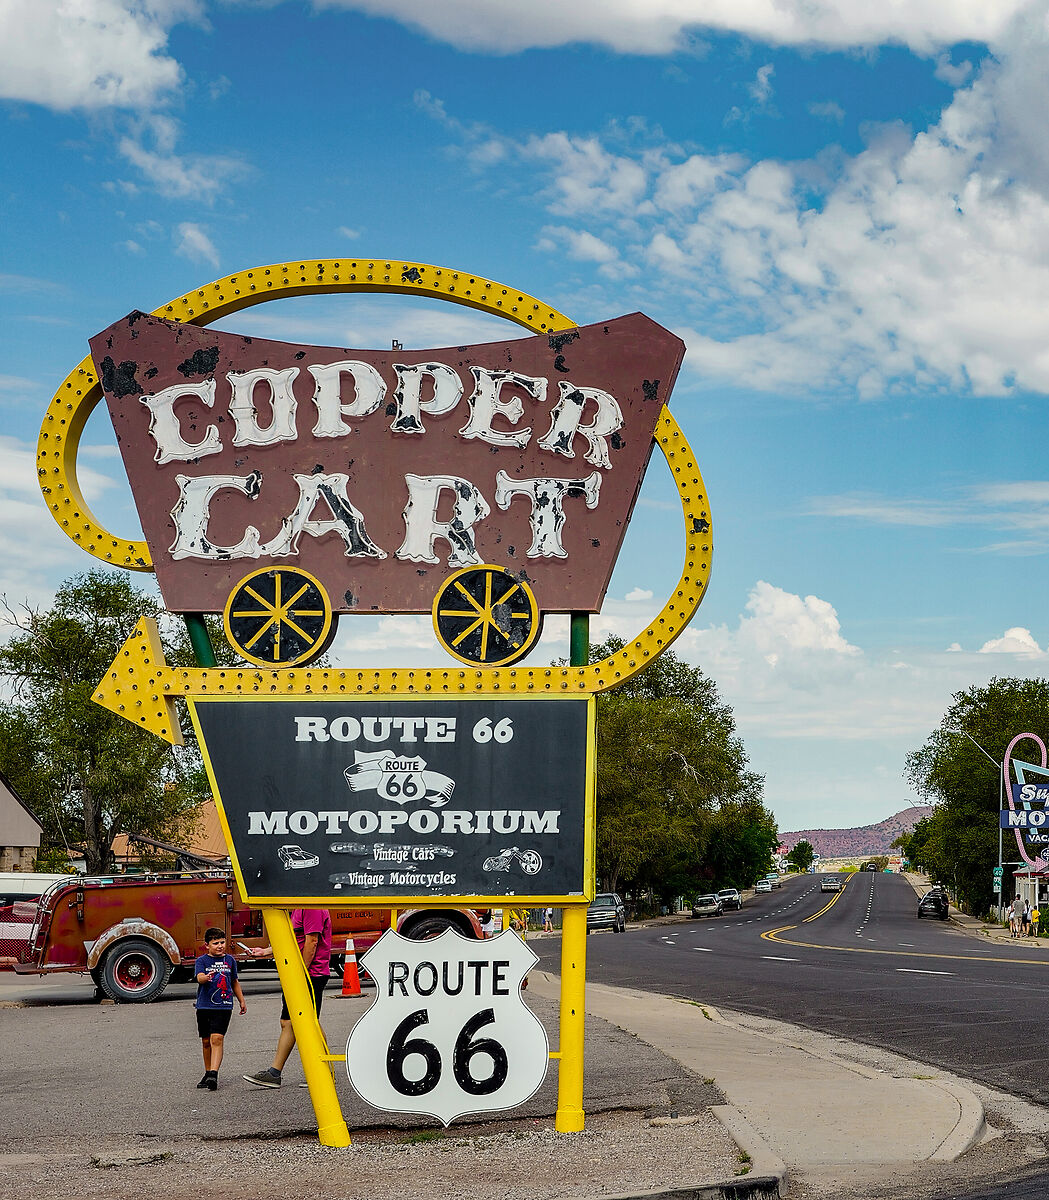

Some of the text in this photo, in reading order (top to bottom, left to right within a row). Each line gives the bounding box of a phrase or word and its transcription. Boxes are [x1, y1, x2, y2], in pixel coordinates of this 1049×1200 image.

[138, 361, 625, 471] COPPER
[167, 470, 603, 569] CART
[294, 716, 514, 744] ROUTE 66
[385, 760, 419, 771] ROUTE
[386, 774, 419, 798] 66
[247, 809, 561, 835] MOTOPORIUM
[373, 847, 409, 864] Vintage
[412, 847, 436, 861] Cars
[349, 871, 457, 888] Vintage Motorcycles
[387, 960, 511, 997] ROUTE
[386, 1007, 509, 1097] 66
